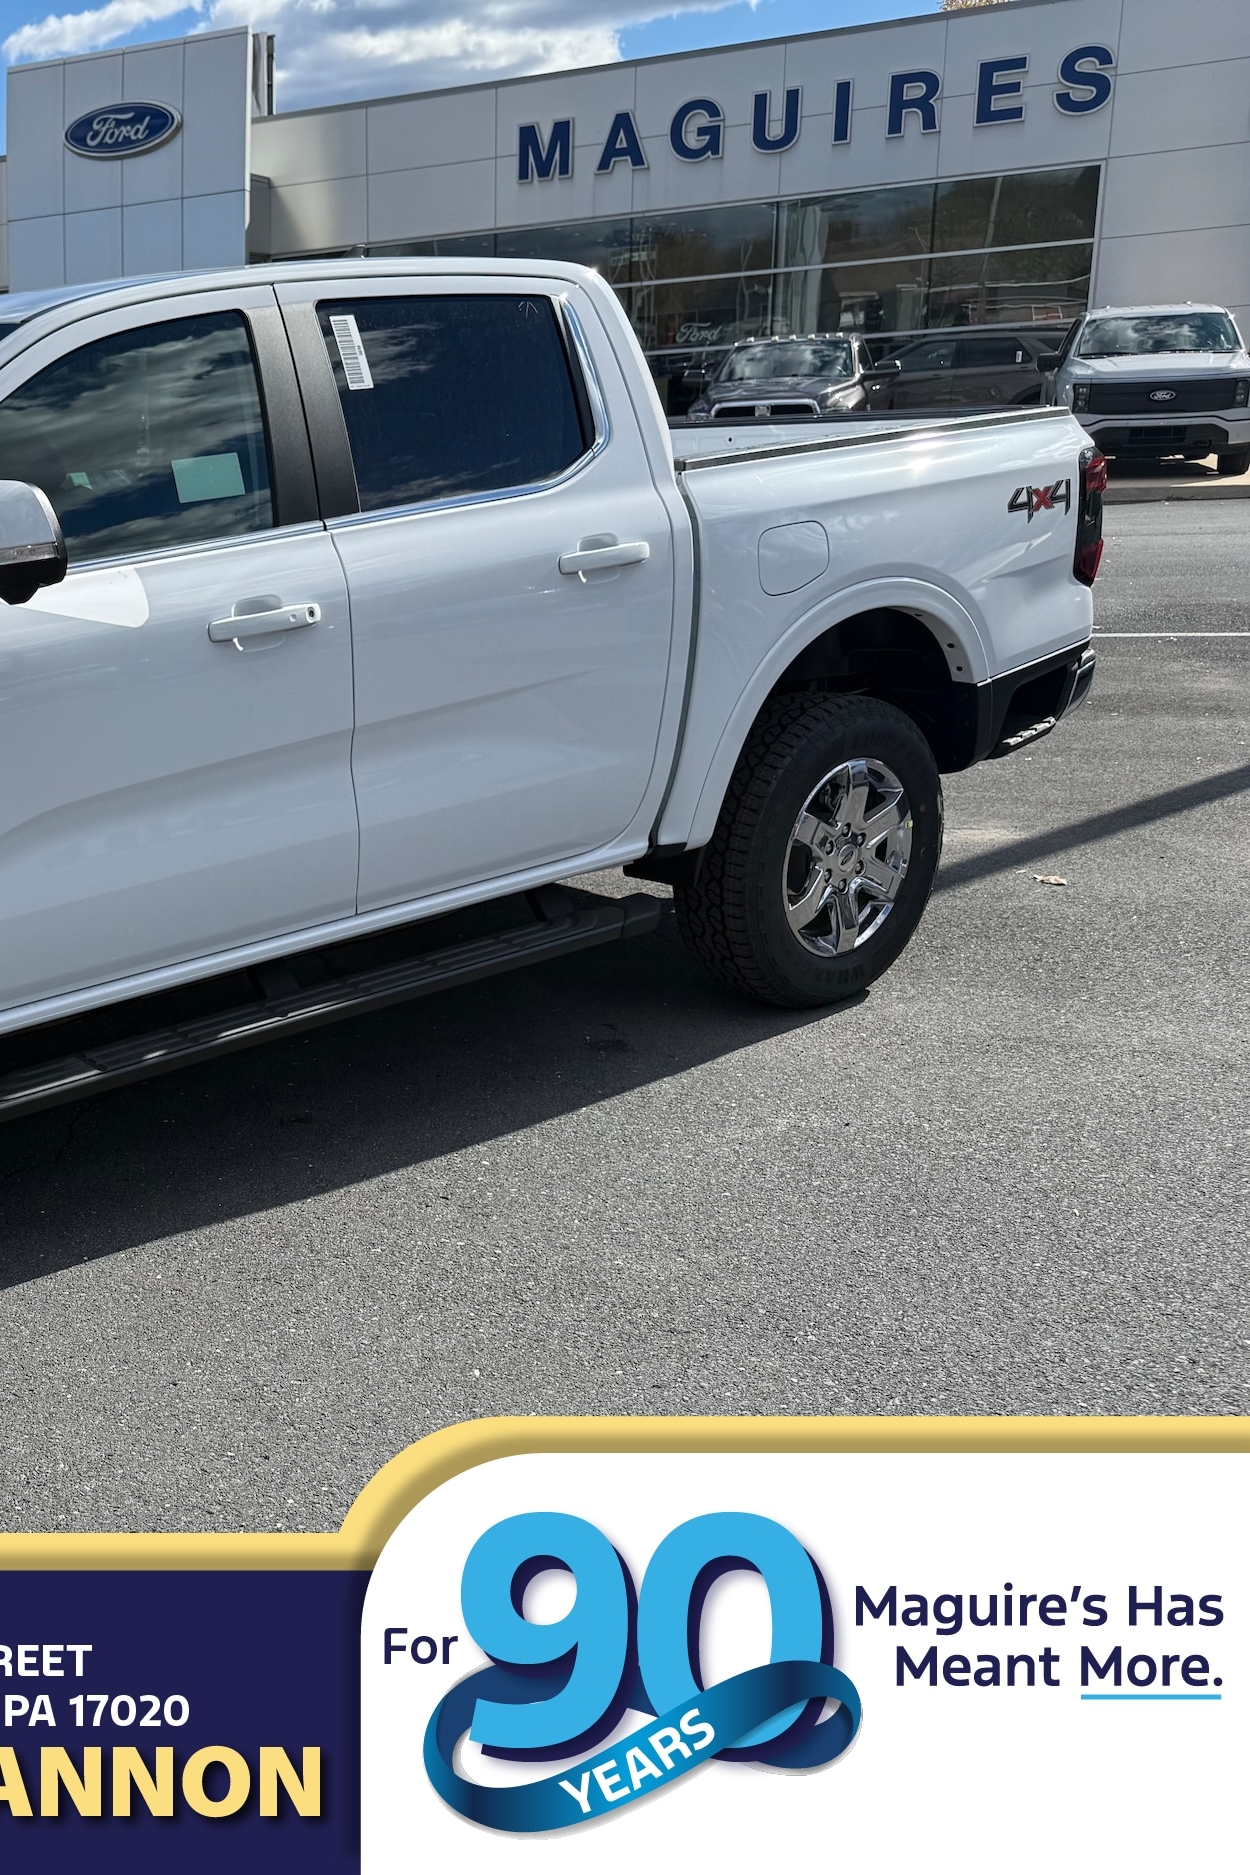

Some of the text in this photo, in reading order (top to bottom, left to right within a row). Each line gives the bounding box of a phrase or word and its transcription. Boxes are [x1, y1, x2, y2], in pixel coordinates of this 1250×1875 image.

[86, 112, 150, 147] Ford
[517, 44, 1117, 184] MAGUIRES
[675, 322, 722, 343] Ford
